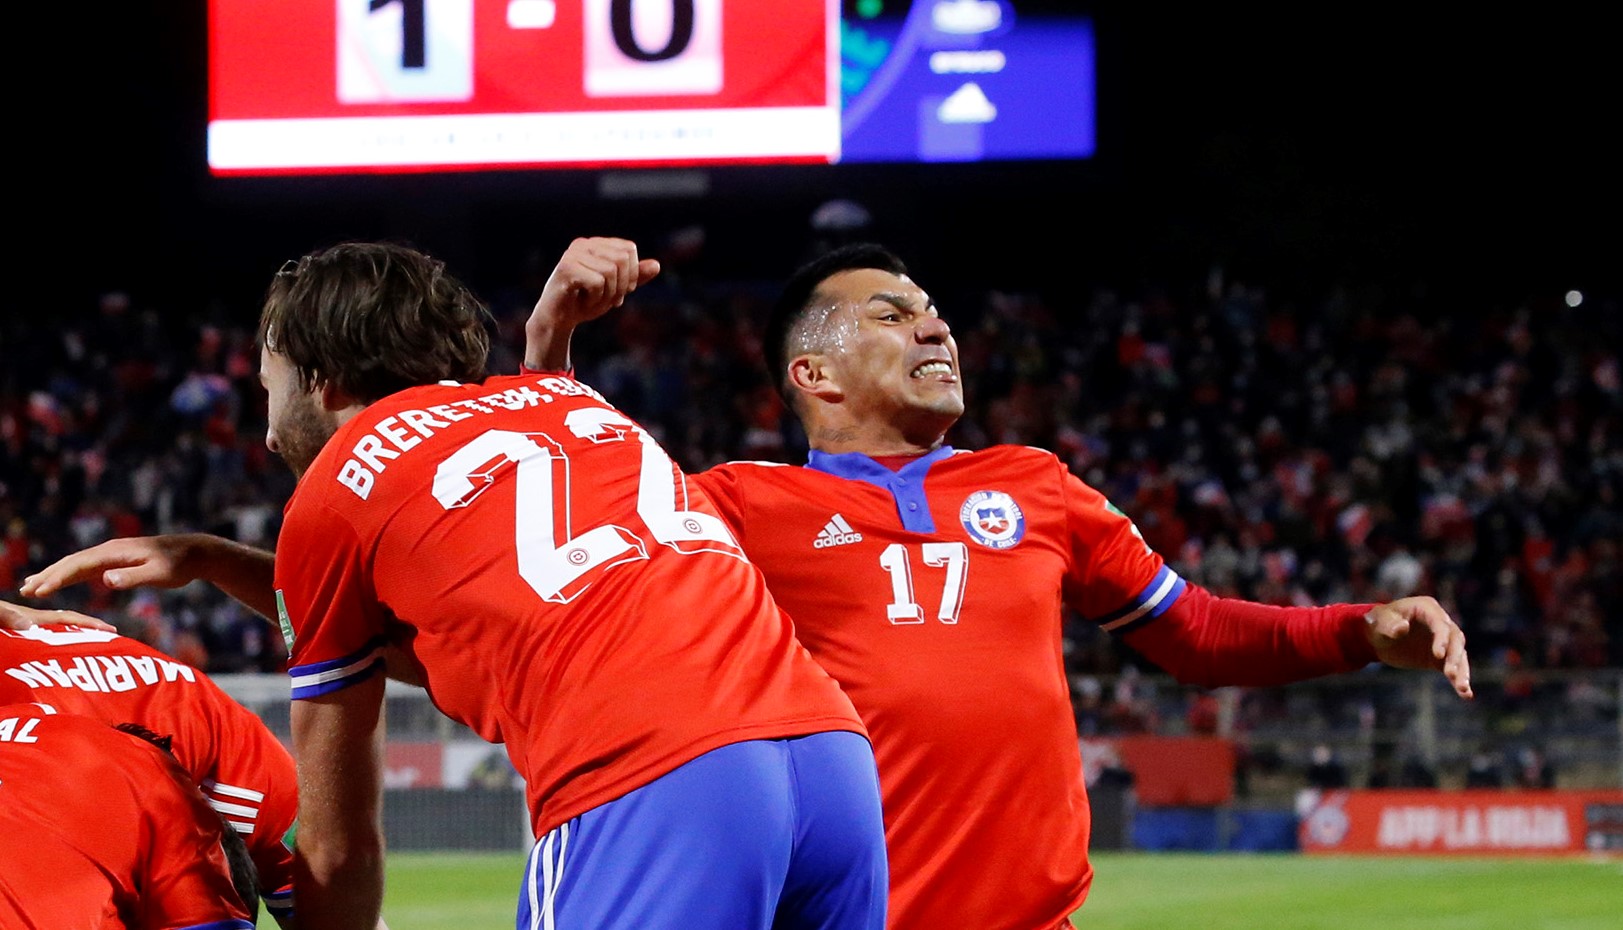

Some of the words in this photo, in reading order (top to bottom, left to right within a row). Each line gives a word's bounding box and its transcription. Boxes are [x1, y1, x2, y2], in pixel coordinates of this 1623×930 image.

[368, 0, 426, 69] 1
[610, 0, 695, 62] 0
[431, 406, 749, 605] 22
[813, 532, 863, 549] adidas
[879, 542, 970, 625] 17
[5, 655, 196, 693] MARIPAN
